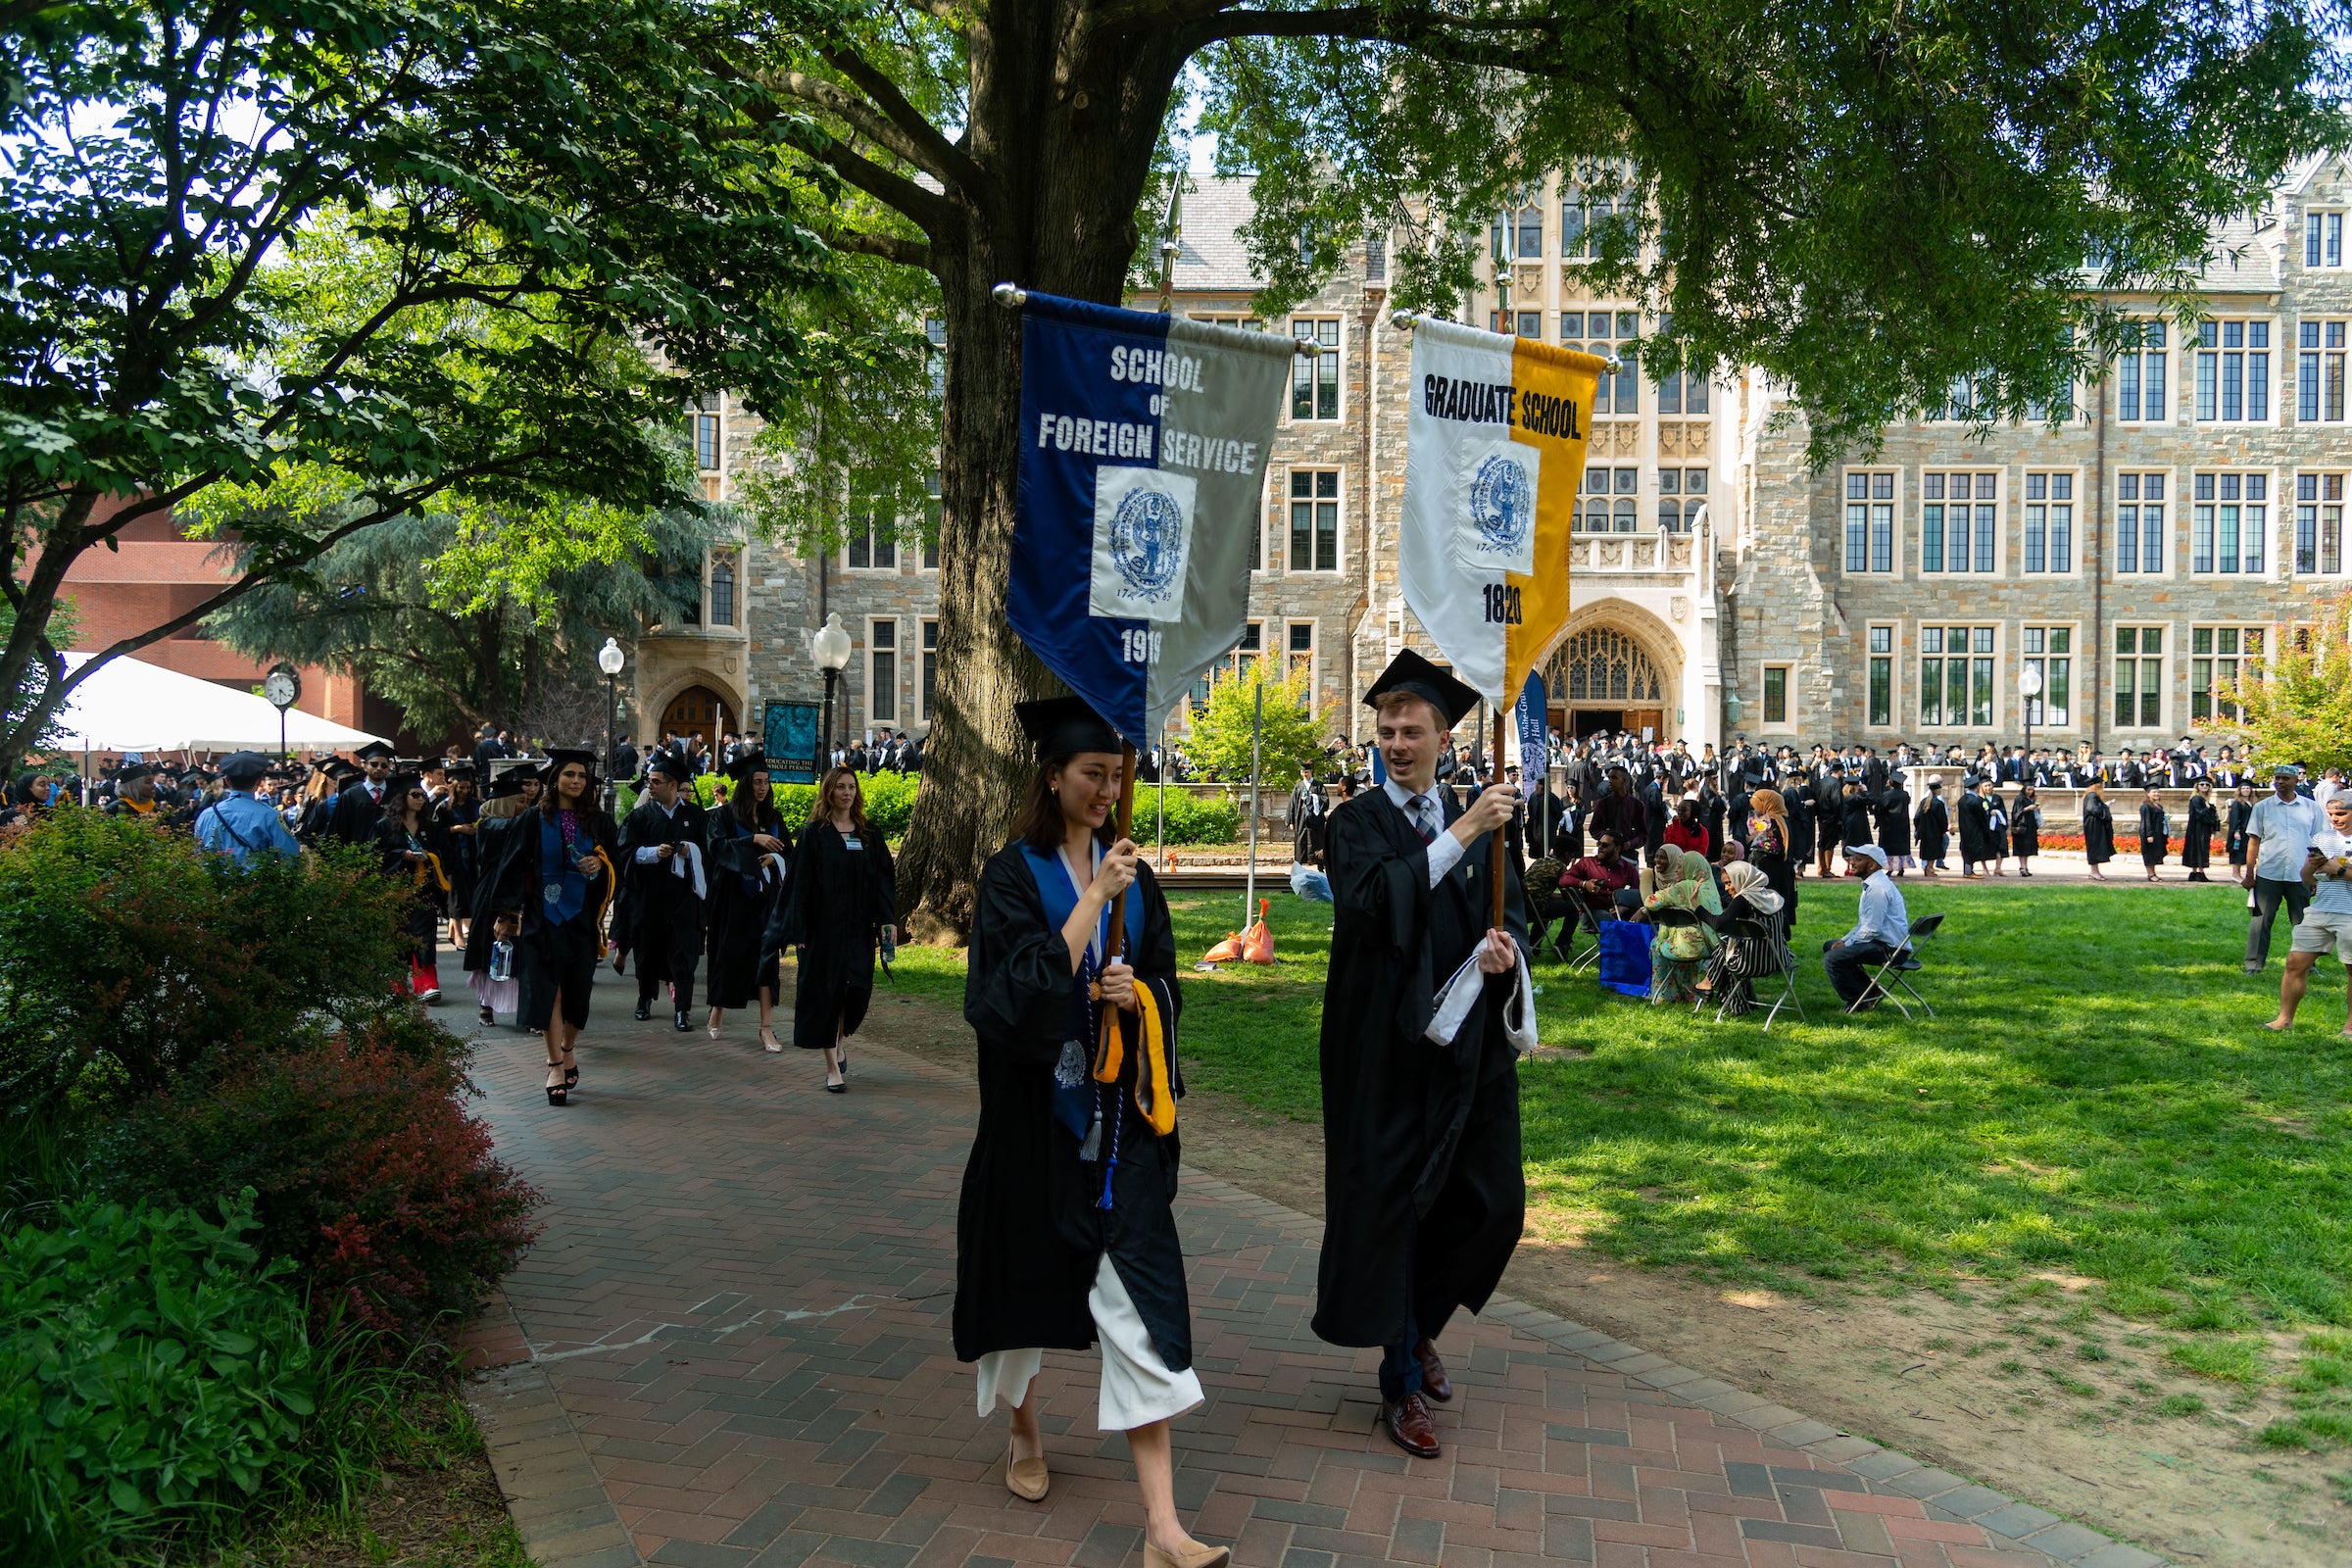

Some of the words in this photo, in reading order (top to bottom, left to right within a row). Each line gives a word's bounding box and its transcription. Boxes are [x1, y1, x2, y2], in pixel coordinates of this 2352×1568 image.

[1110, 345, 1204, 393] SCHOOL
[1149, 394, 1171, 417] OF
[1424, 373, 1517, 426] GRADUATE
[1522, 390, 1582, 440] SCHOOL
[1038, 413, 1153, 460] FOREIGN
[1163, 428, 1258, 475] SERVICE
[1115, 589, 1127, 599] 17
[1161, 592, 1172, 602] 89
[1483, 583, 1523, 625] 1820
[1120, 628, 1162, 665] 1919
[1530, 718, 1541, 738] Hall
